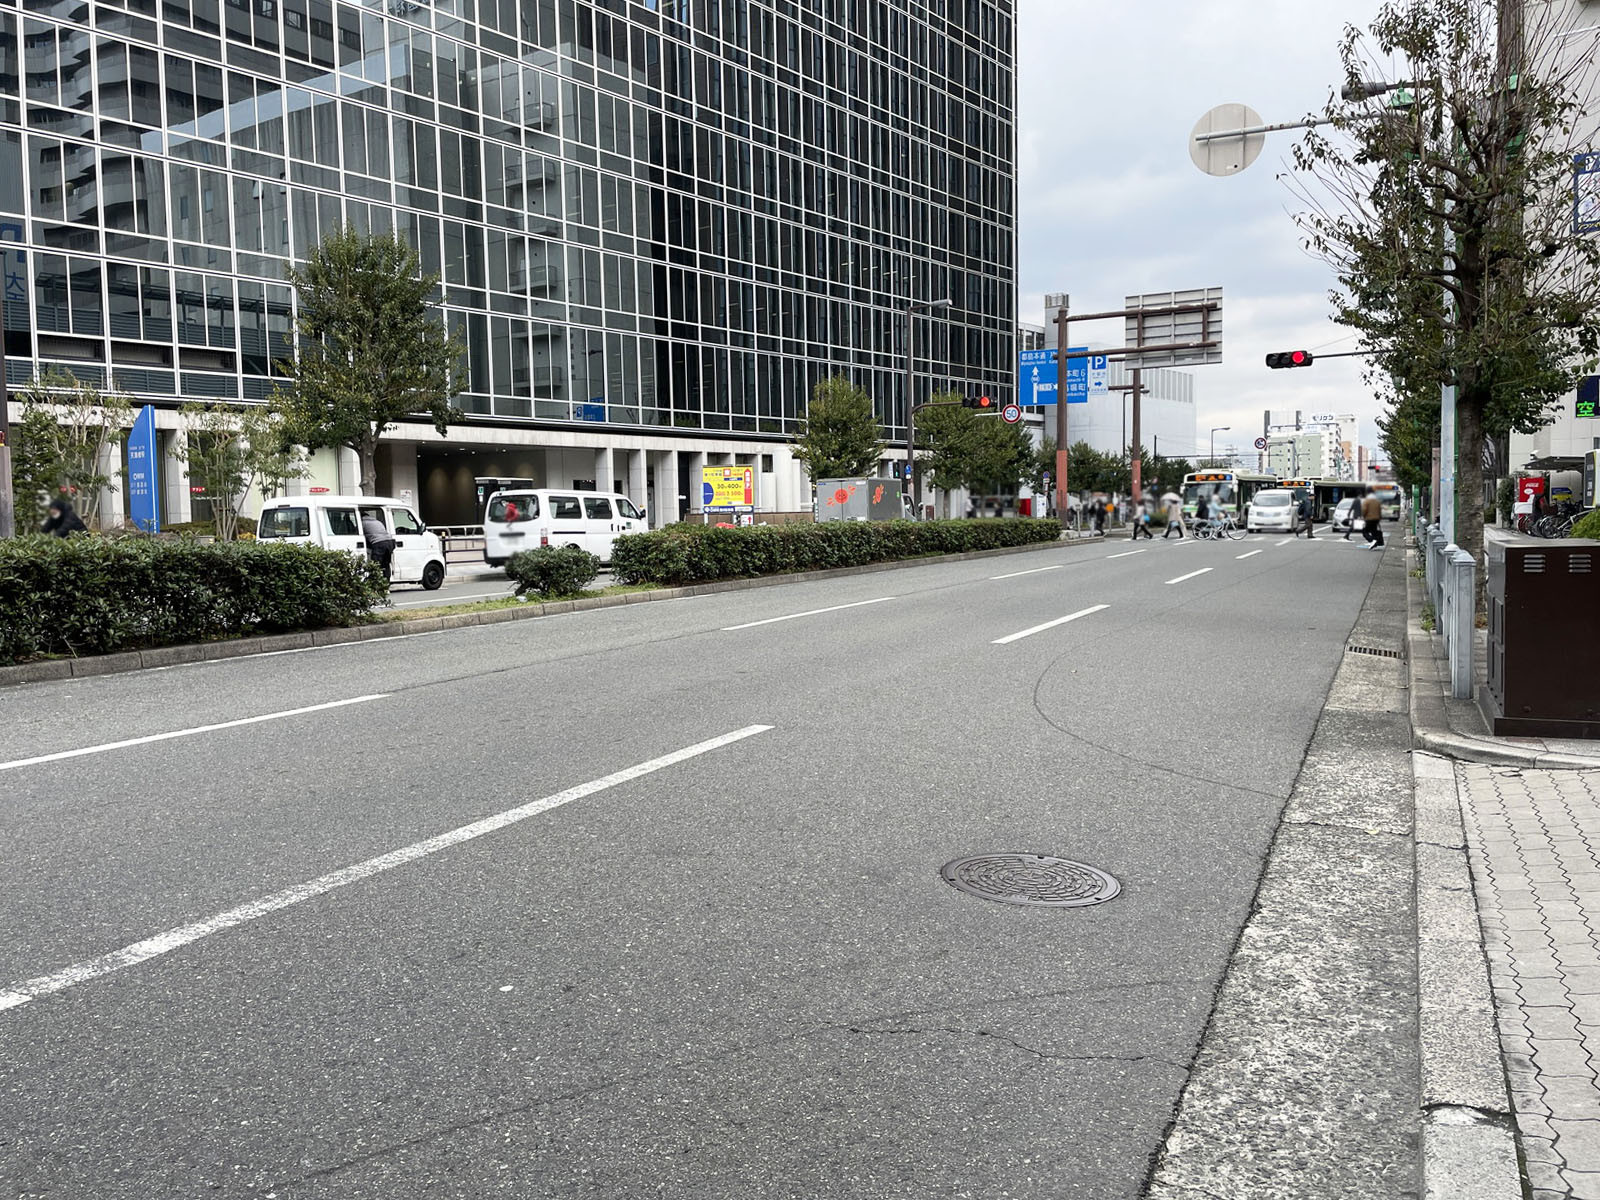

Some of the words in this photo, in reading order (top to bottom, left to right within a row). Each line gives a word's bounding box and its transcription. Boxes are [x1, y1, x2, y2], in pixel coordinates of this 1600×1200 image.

[1094, 356, 1103, 368] P
[1006, 409, 1018, 419] 50
[1577, 401, 1595, 417] 空
